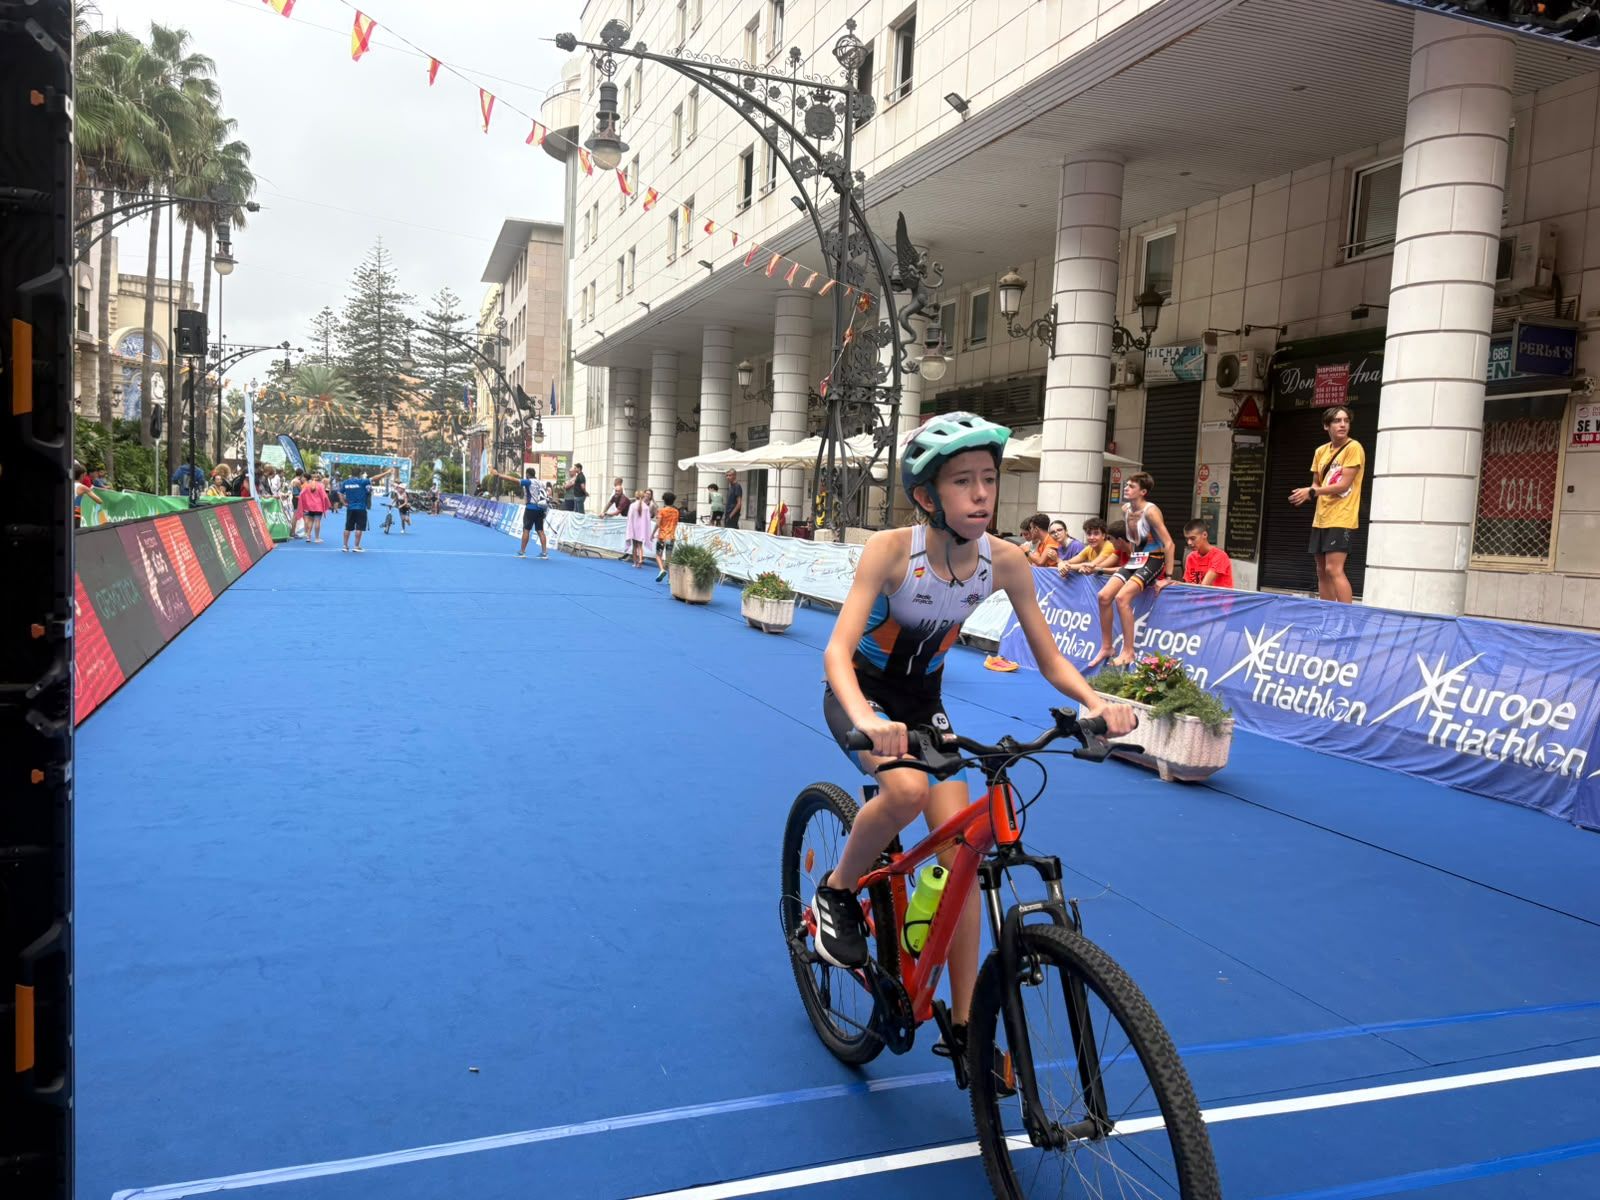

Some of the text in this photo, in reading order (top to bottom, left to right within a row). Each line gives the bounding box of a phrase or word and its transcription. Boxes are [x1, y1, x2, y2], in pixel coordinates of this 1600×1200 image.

[1520, 342, 1573, 359] PERLA'S
[1280, 367, 1316, 395] Don
[1577, 420, 1591, 432] SE
[1499, 477, 1542, 511] TOTAL
[1052, 631, 1095, 660] thlon
[1260, 642, 1358, 687] Europe
[1252, 672, 1367, 726] Triathlon
[1438, 673, 1576, 730] Europe
[1428, 709, 1587, 779] Triathlon
